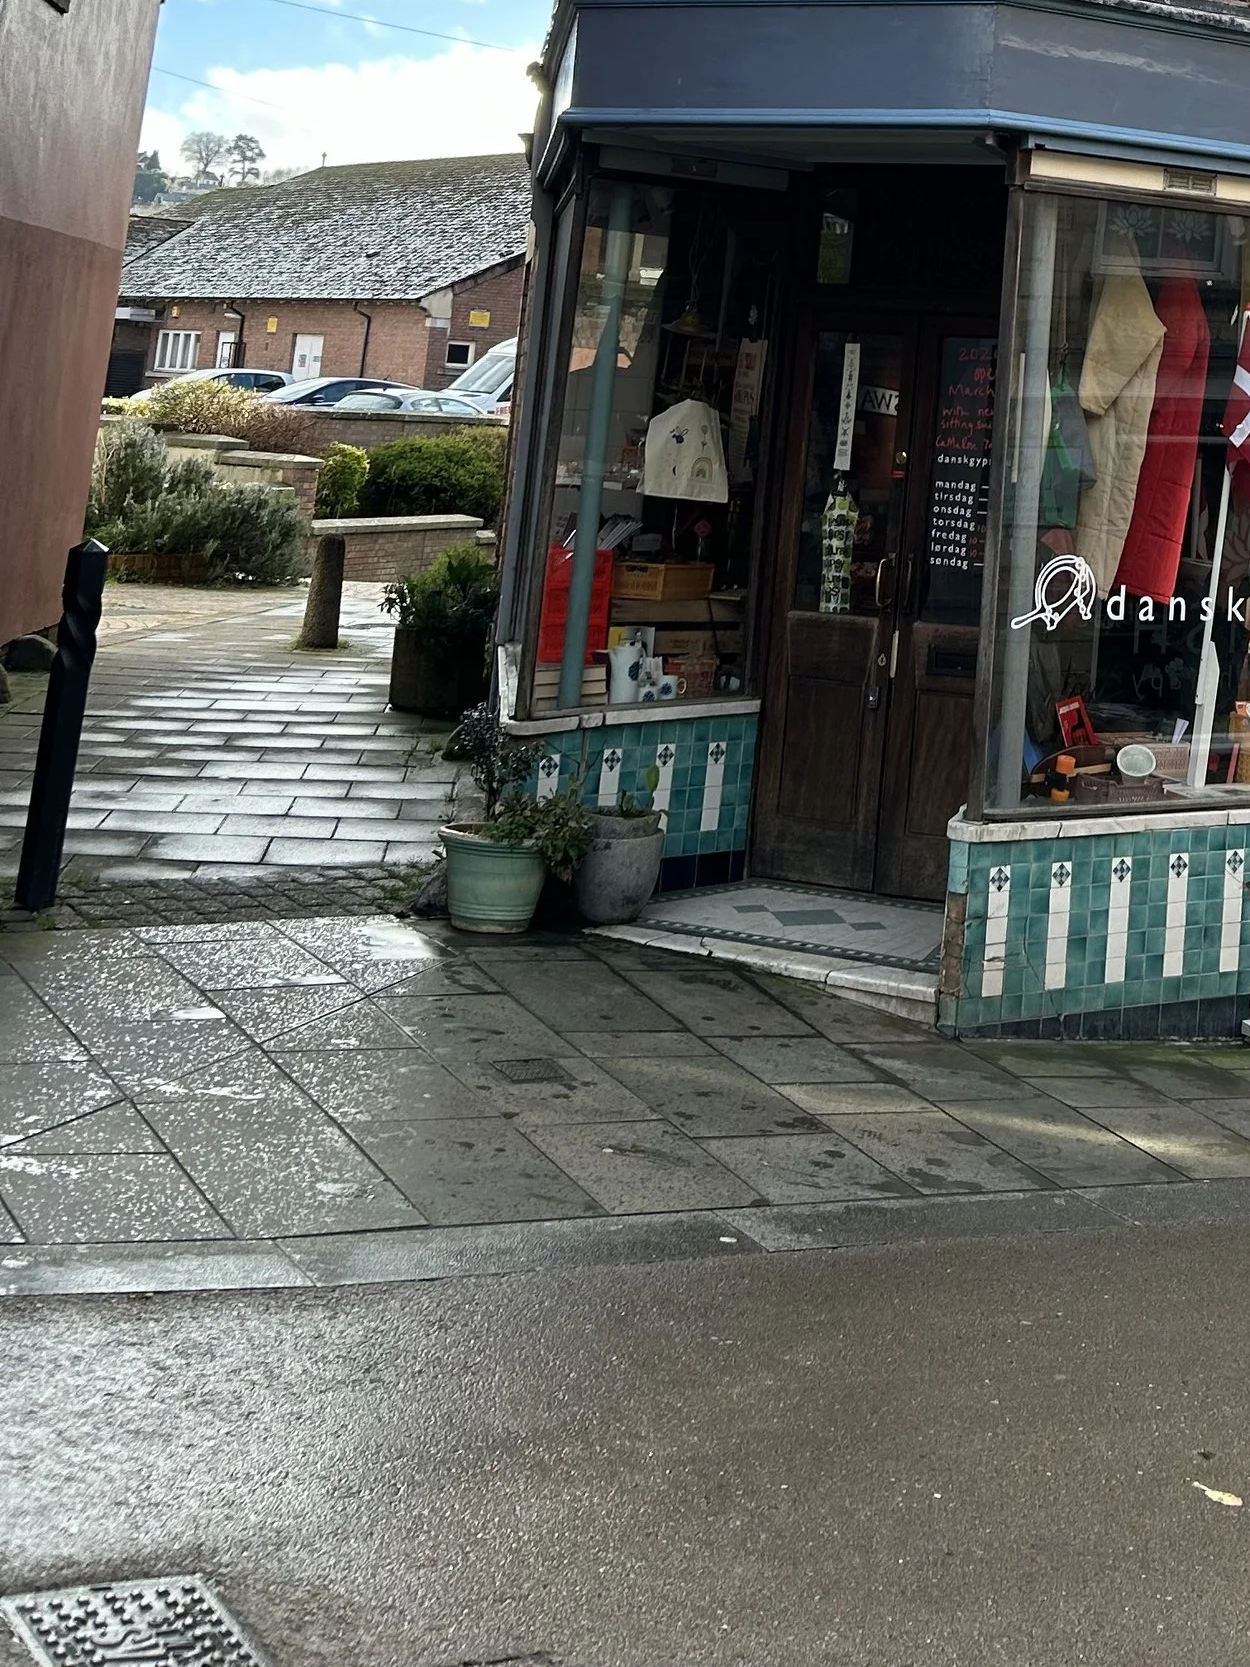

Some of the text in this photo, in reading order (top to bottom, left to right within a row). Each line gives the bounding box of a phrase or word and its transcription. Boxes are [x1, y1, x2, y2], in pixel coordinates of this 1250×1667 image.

[935, 480, 977, 493] mandag
[934, 492, 974, 505] tirsdag
[933, 505, 972, 518] onsdag
[932, 518, 976, 532] torsdag
[931, 529, 967, 544] fredag
[931, 542, 967, 557] lørdag
[930, 556, 969, 570] søndag
